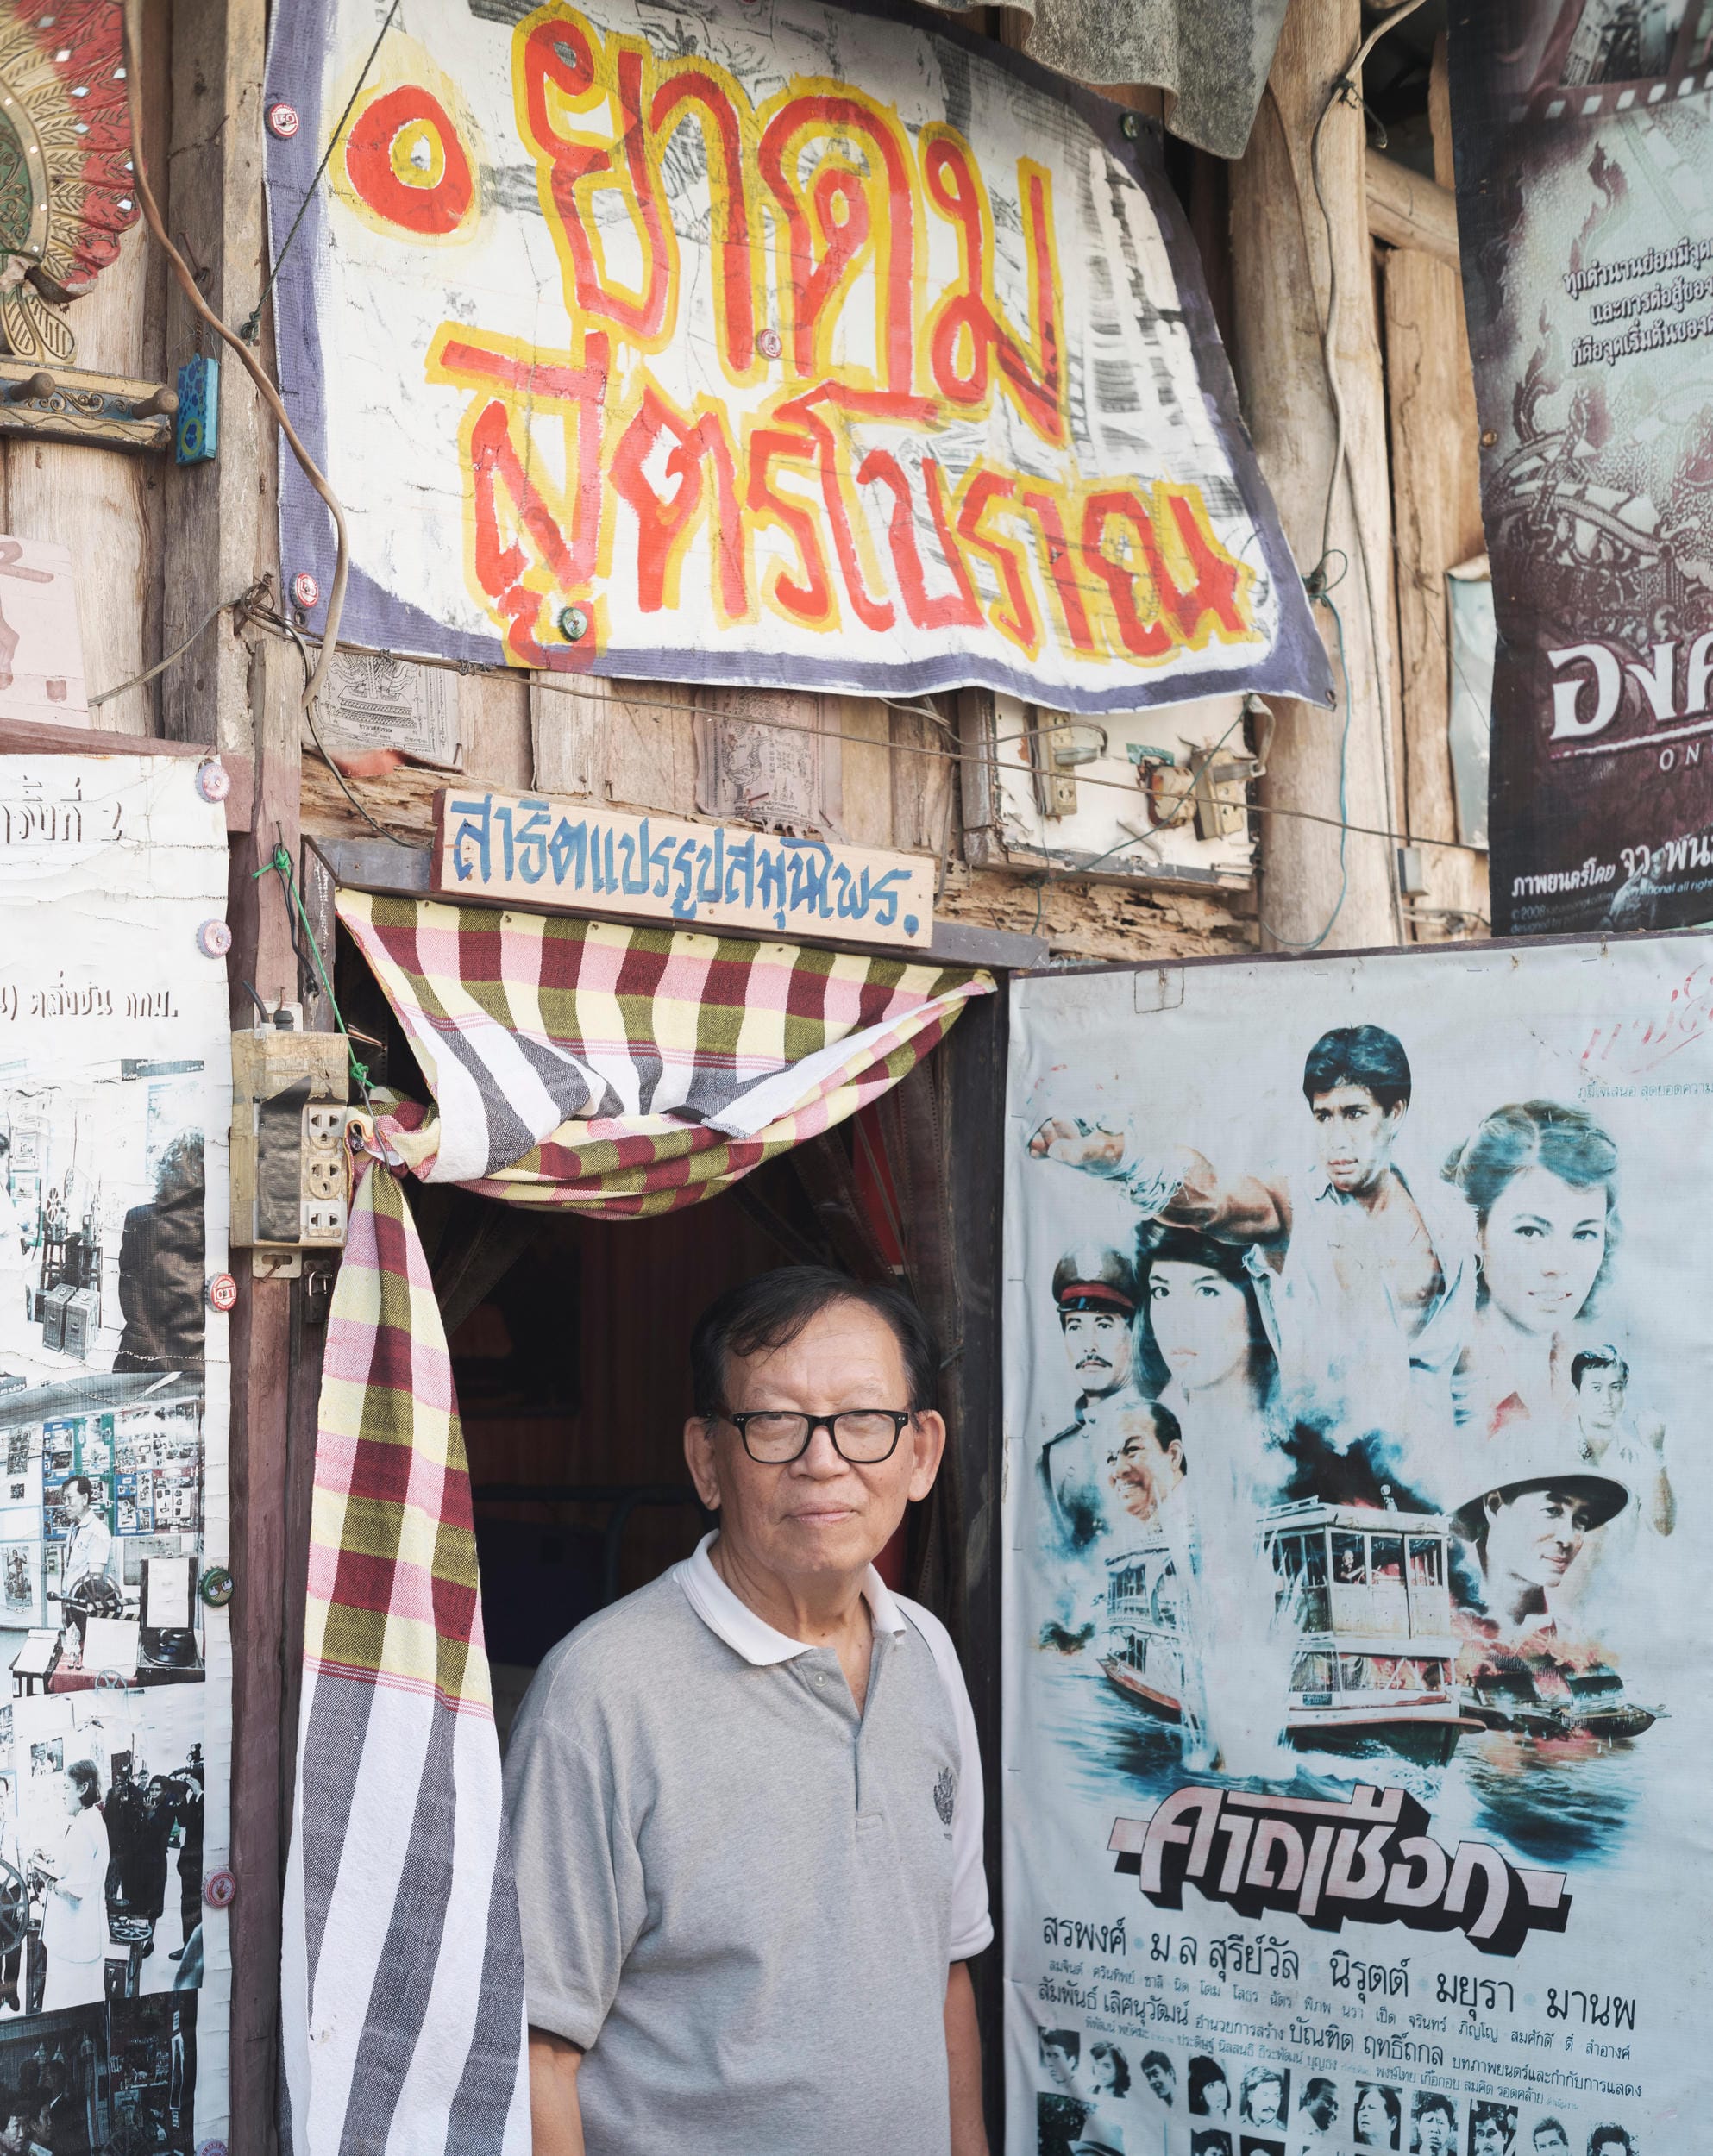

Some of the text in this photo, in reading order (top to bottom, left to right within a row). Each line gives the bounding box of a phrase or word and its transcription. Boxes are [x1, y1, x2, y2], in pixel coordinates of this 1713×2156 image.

[516, 7, 1066, 446] ยาดม
[430, 326, 1255, 671] สูตรโบราณ
[1038, 1975, 1098, 2011] สัมพันธ์
[1289, 2015, 1355, 2053] บัณฑิต
[1364, 2031, 1445, 2066] ฤทธิ์ถกล
[1042, 1916, 1126, 1957] สรพงศ์
[1329, 1948, 1412, 2005] นิรุตต์
[1435, 1971, 1515, 2022] มยุรา
[1546, 1986, 1636, 2031] มานพ
